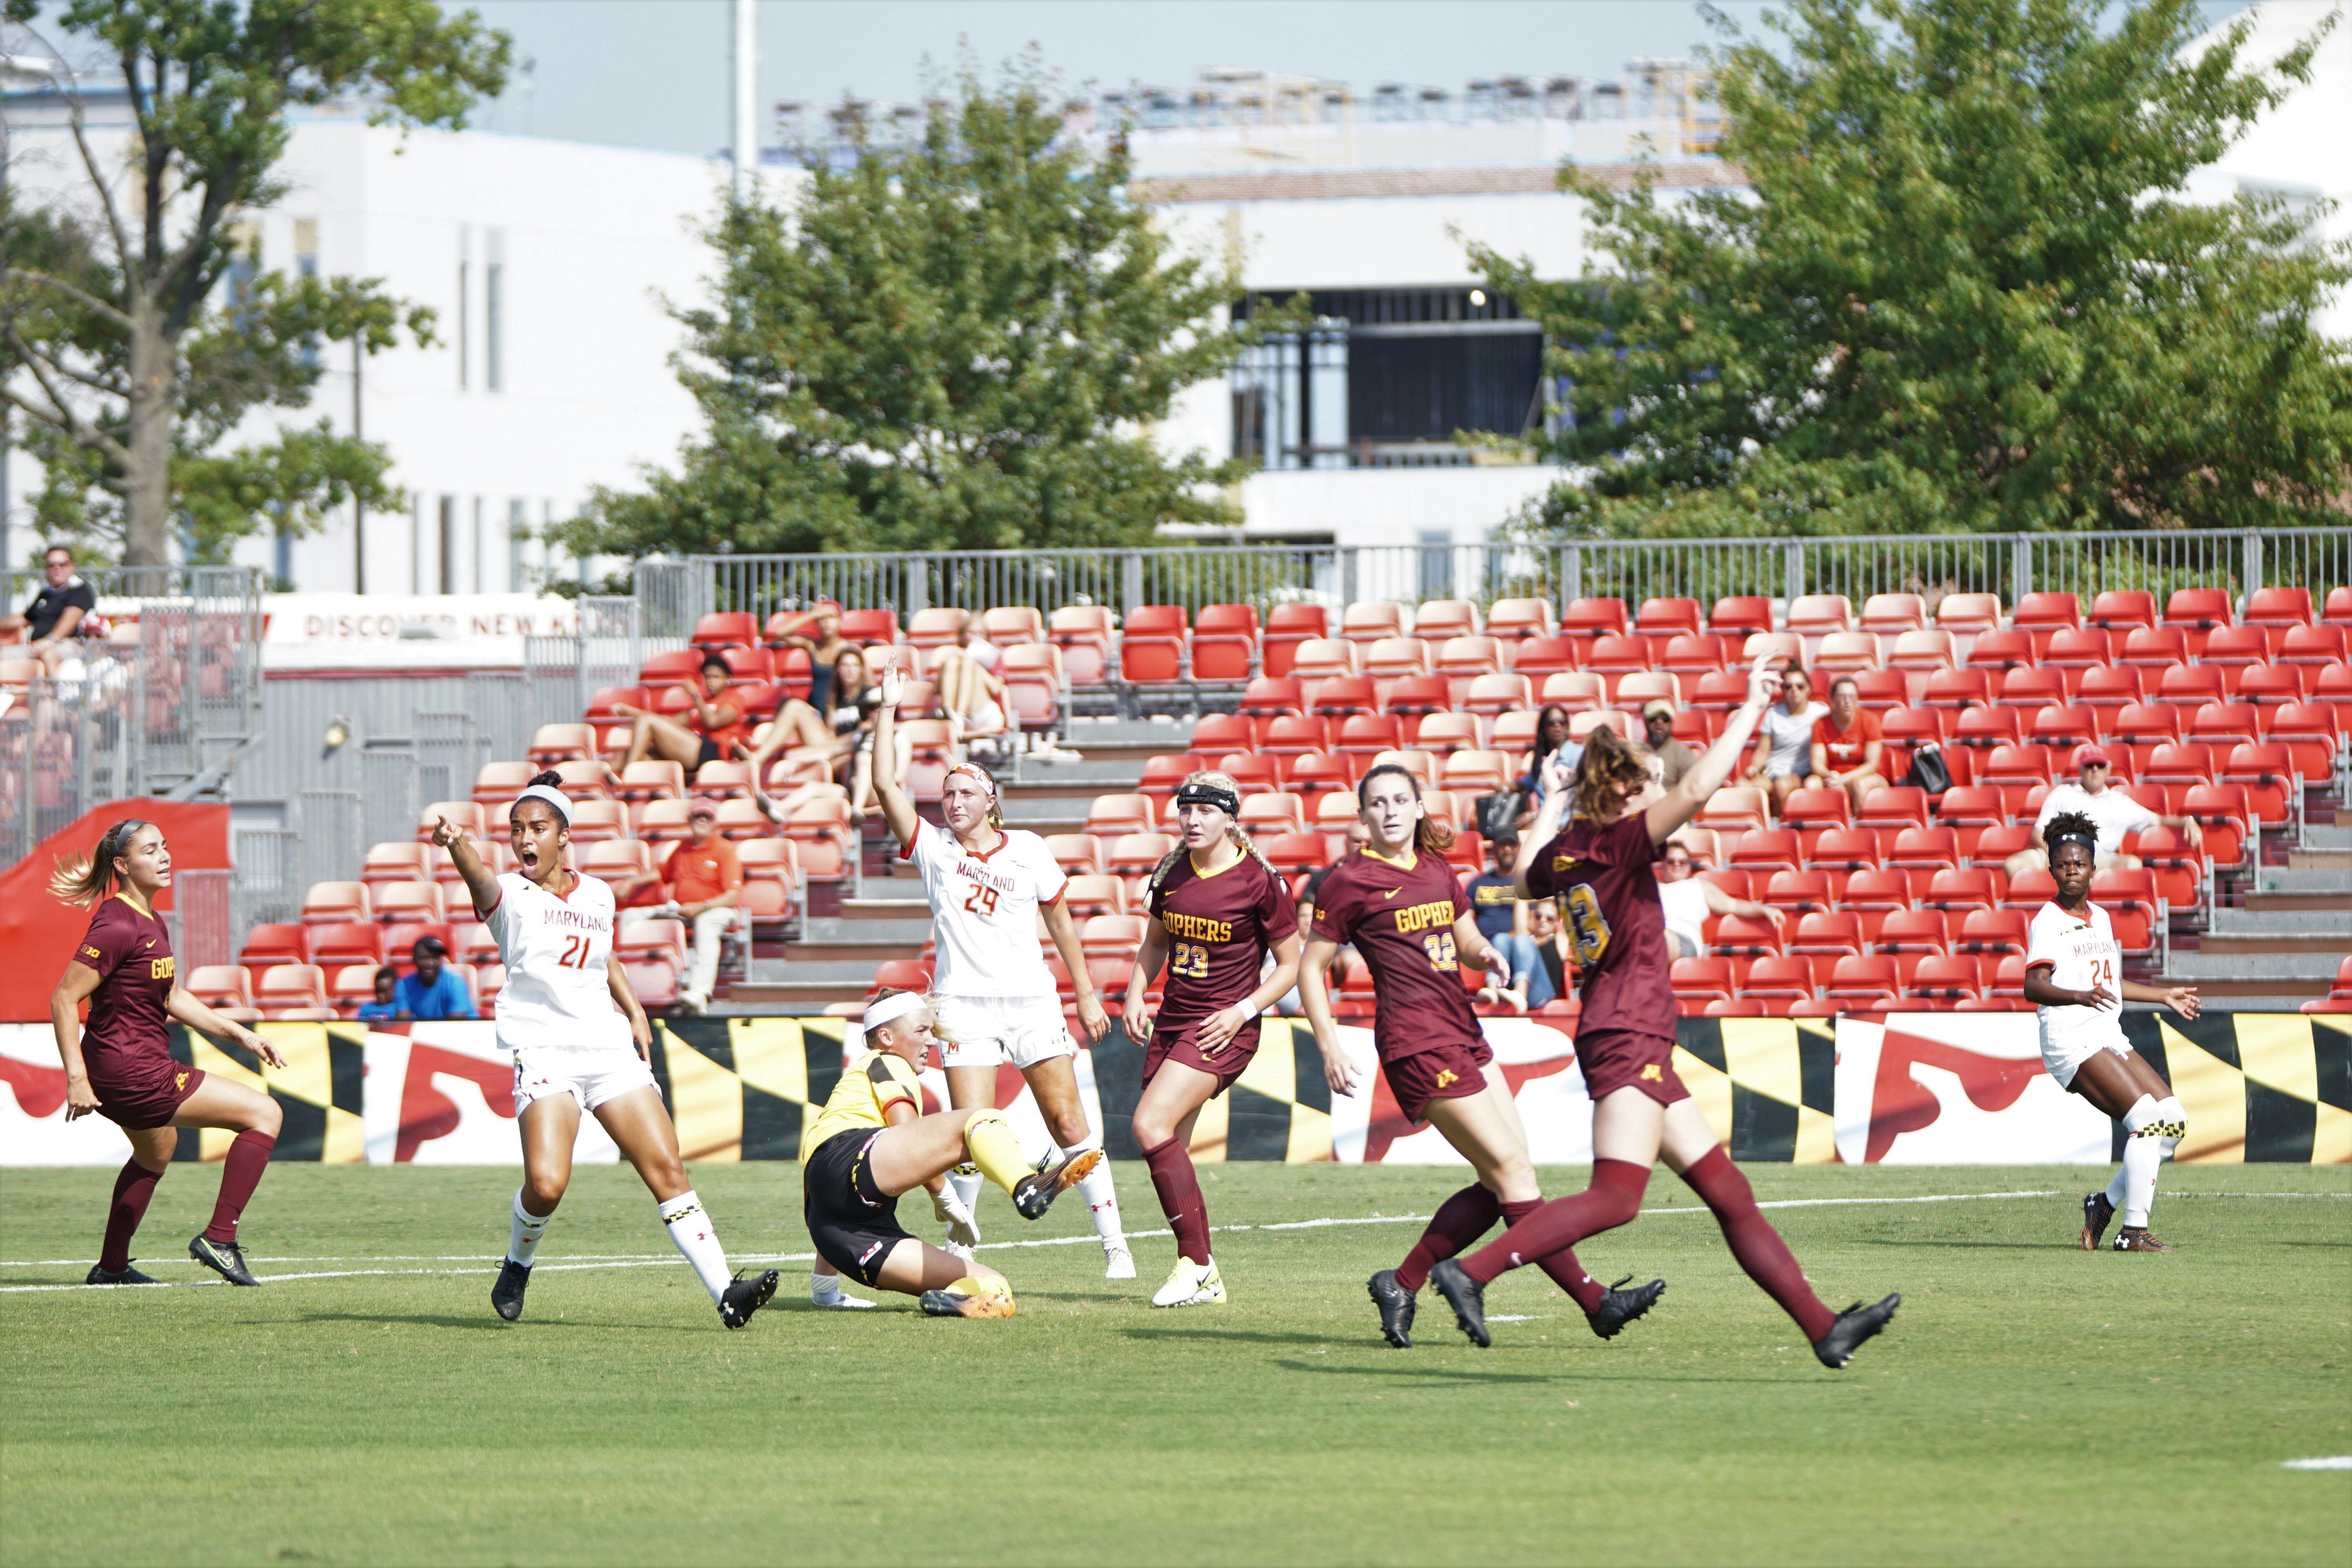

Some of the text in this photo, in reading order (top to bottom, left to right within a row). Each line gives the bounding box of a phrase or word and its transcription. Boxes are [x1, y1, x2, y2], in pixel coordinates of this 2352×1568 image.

[471, 614, 533, 635] NEW
[957, 861, 1014, 891] MARYLAND
[964, 882, 1000, 918] 29
[544, 909, 608, 932] MARYLAND
[1163, 910, 1232, 942] GOPHERS
[557, 933, 592, 970] 21
[1172, 942, 1209, 978] 23
[1423, 932, 1459, 973] 22
[2090, 959, 2113, 987] 24
